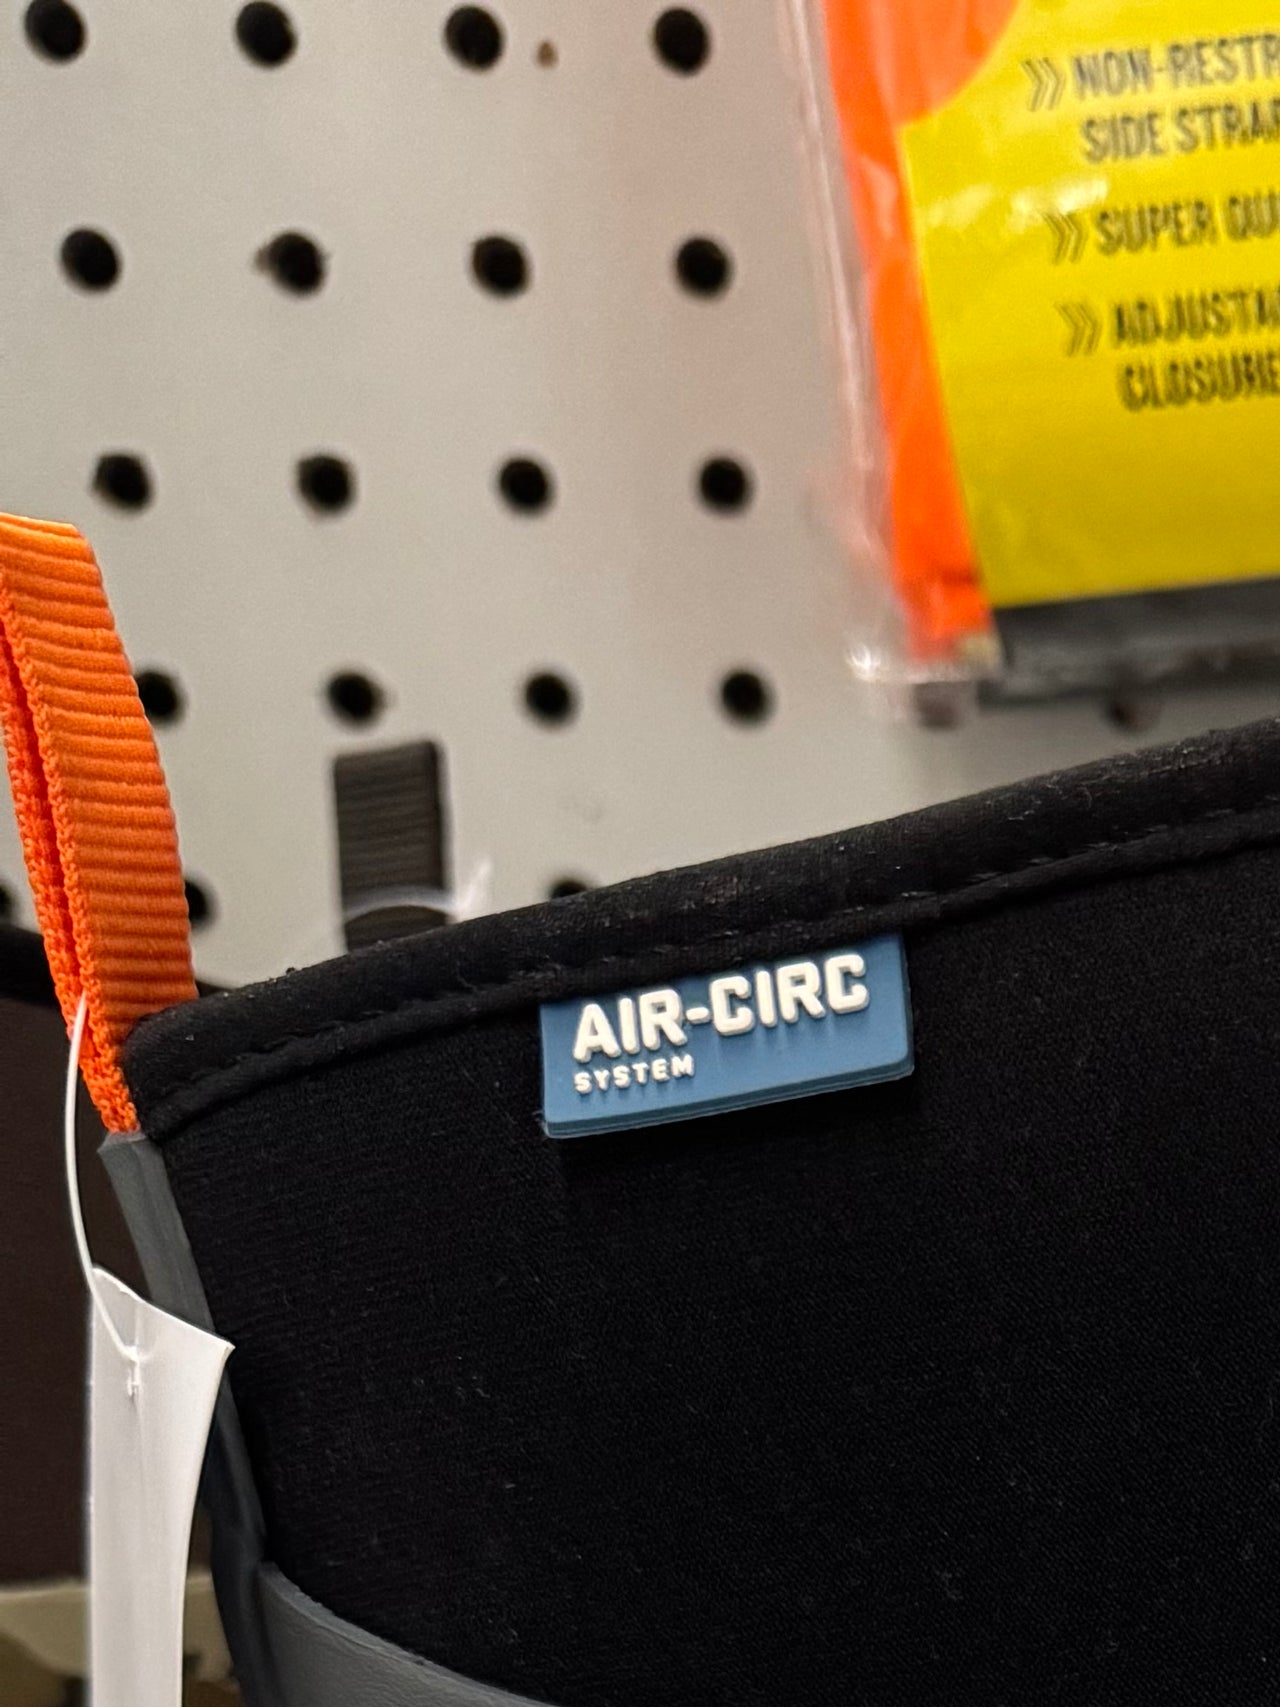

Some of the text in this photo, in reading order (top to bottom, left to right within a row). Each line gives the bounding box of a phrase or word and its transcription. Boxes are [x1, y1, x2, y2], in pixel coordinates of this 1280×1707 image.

[1081, 111, 1168, 163] SIDE
[1095, 201, 1220, 255] SUPER
[573, 954, 869, 1063] AIR-CIRC
[574, 1053, 695, 1094] SYSTEM
